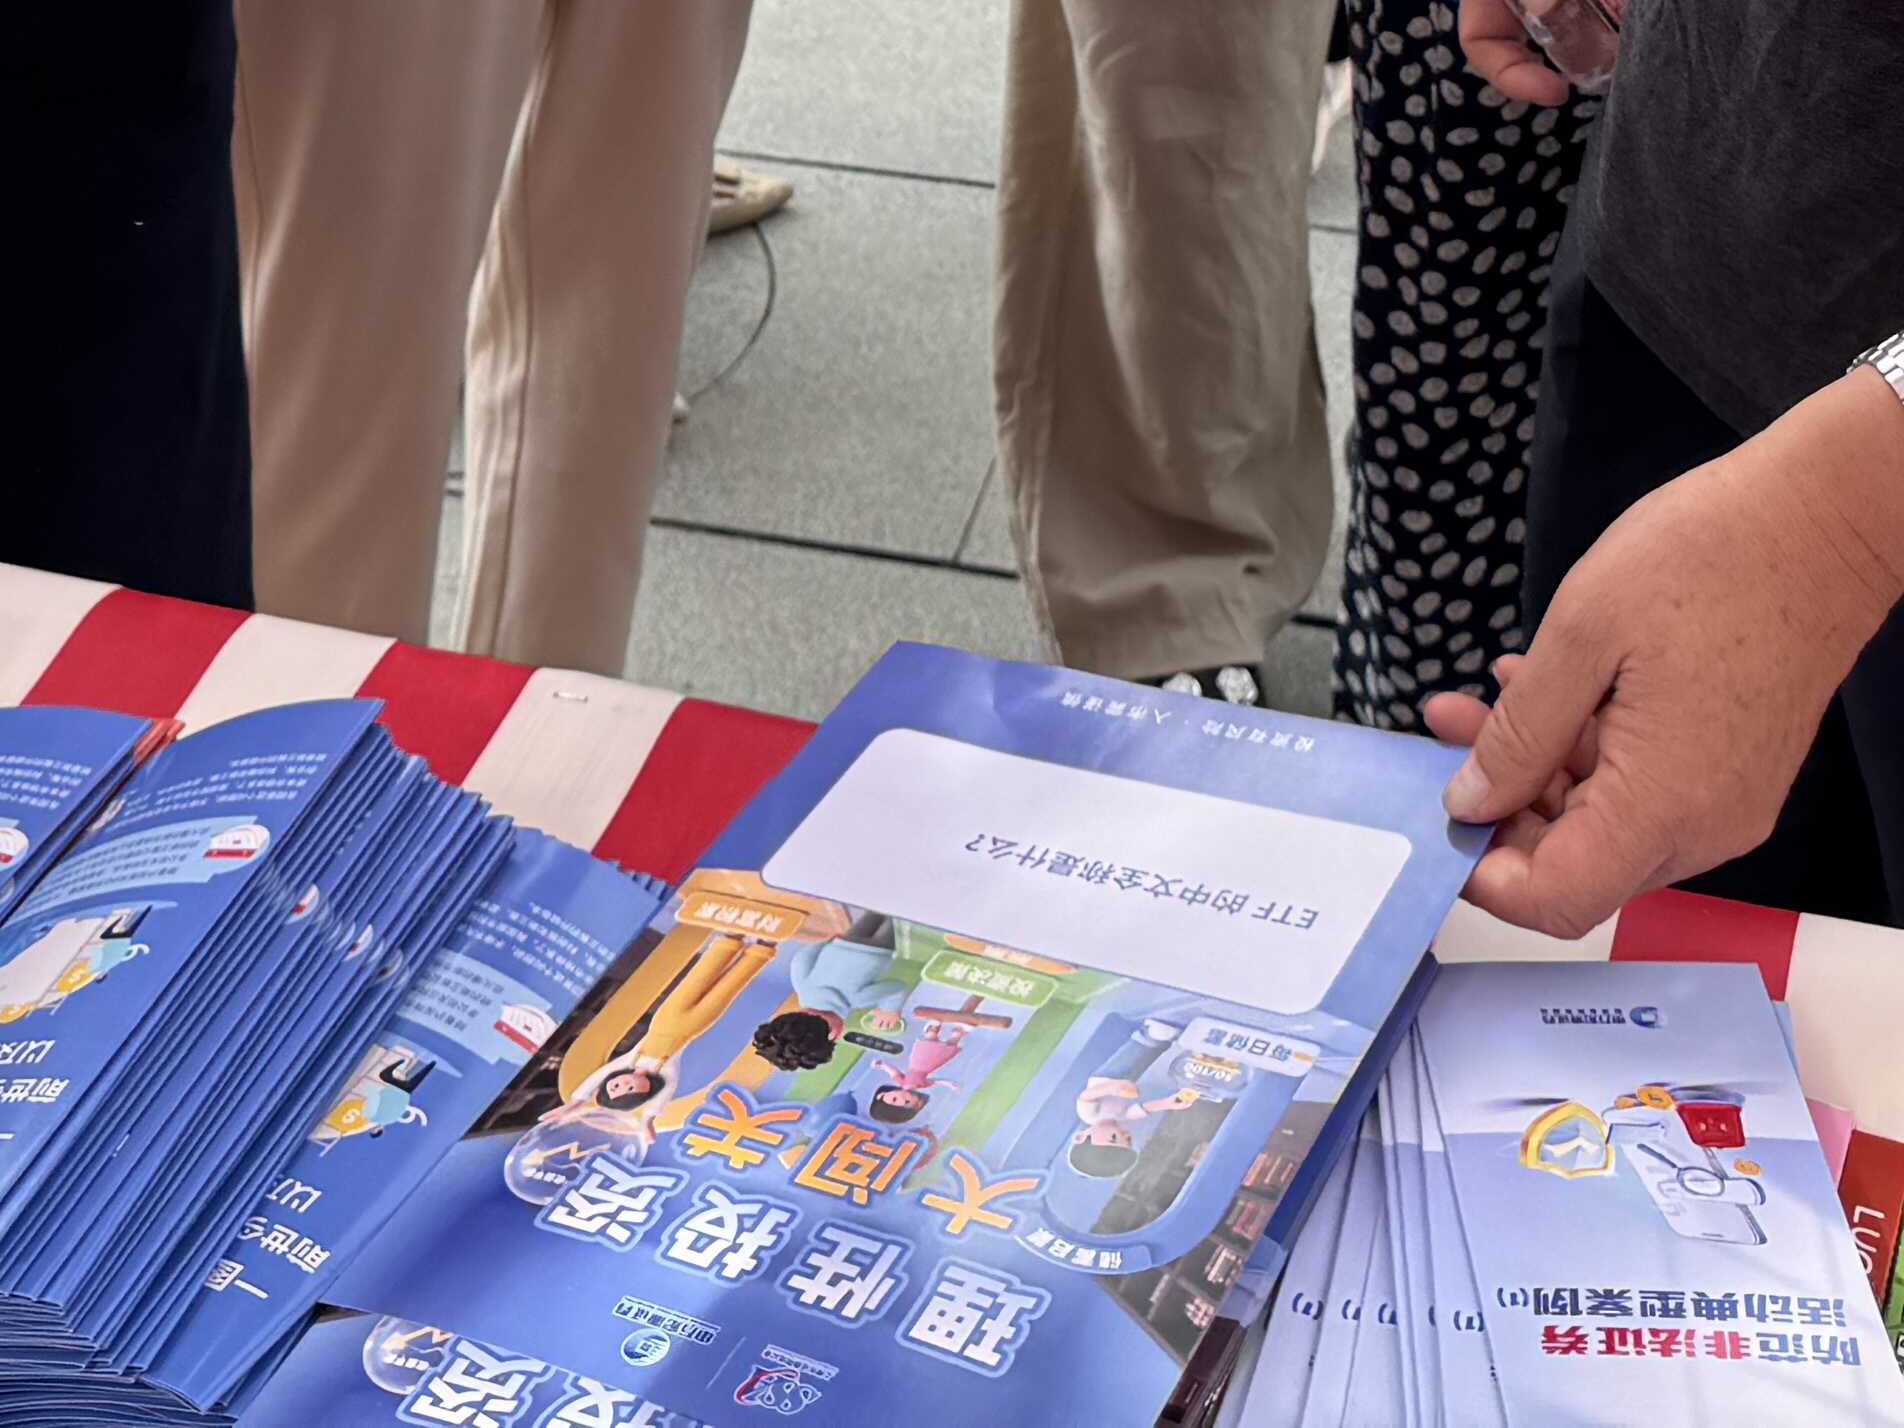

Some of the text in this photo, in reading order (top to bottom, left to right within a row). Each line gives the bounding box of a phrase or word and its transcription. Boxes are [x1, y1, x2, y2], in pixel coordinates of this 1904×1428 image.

[1201, 717, 1317, 754] 投资有风险
[1254, 897, 1320, 931] ETF
[1202, 1028, 1292, 1062] 每日储蓄
[683, 1087, 1038, 1235] 大闯关
[546, 1151, 1040, 1368] 理性投资
[1027, 1228, 1122, 1270] 储蓄启蒙
[1496, 1287, 1846, 1328] 活动典型案例(1)
[1539, 1325, 1861, 1368] 防范非法证券
